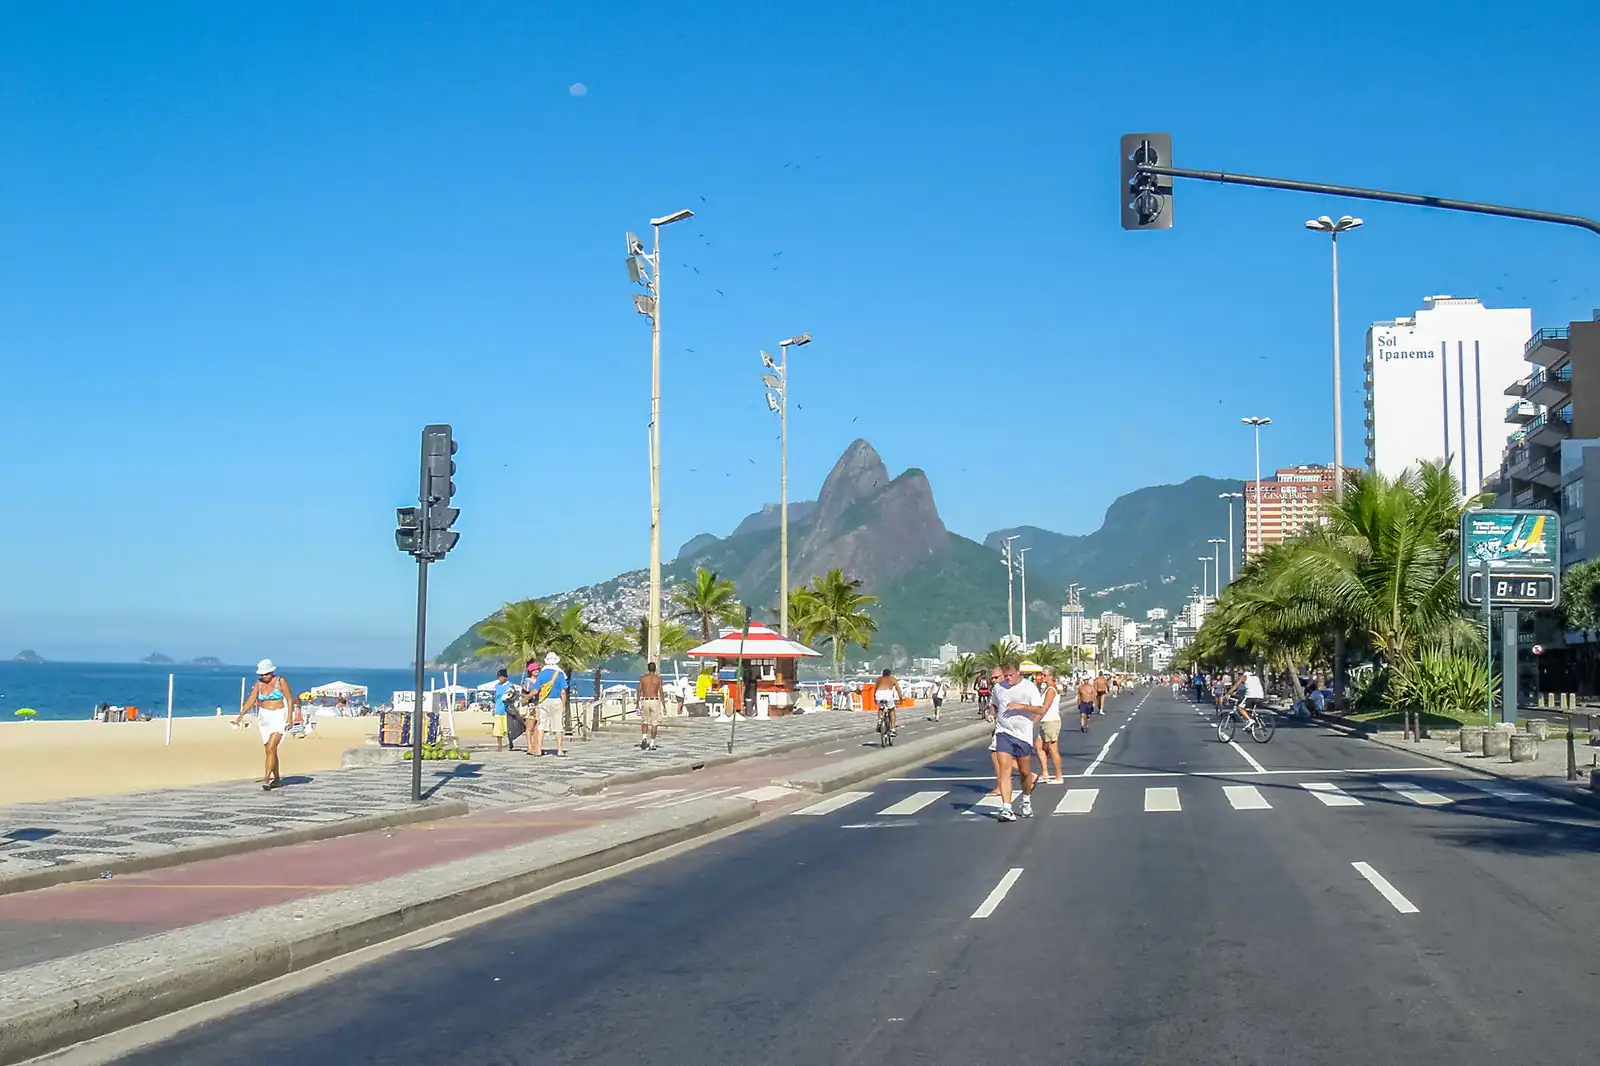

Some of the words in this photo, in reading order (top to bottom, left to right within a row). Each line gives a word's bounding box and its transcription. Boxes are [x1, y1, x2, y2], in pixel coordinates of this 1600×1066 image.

[1378, 336, 1397, 346] Sol
[1379, 349, 1434, 362] Ipanema
[1496, 582, 1537, 597] 8:16
